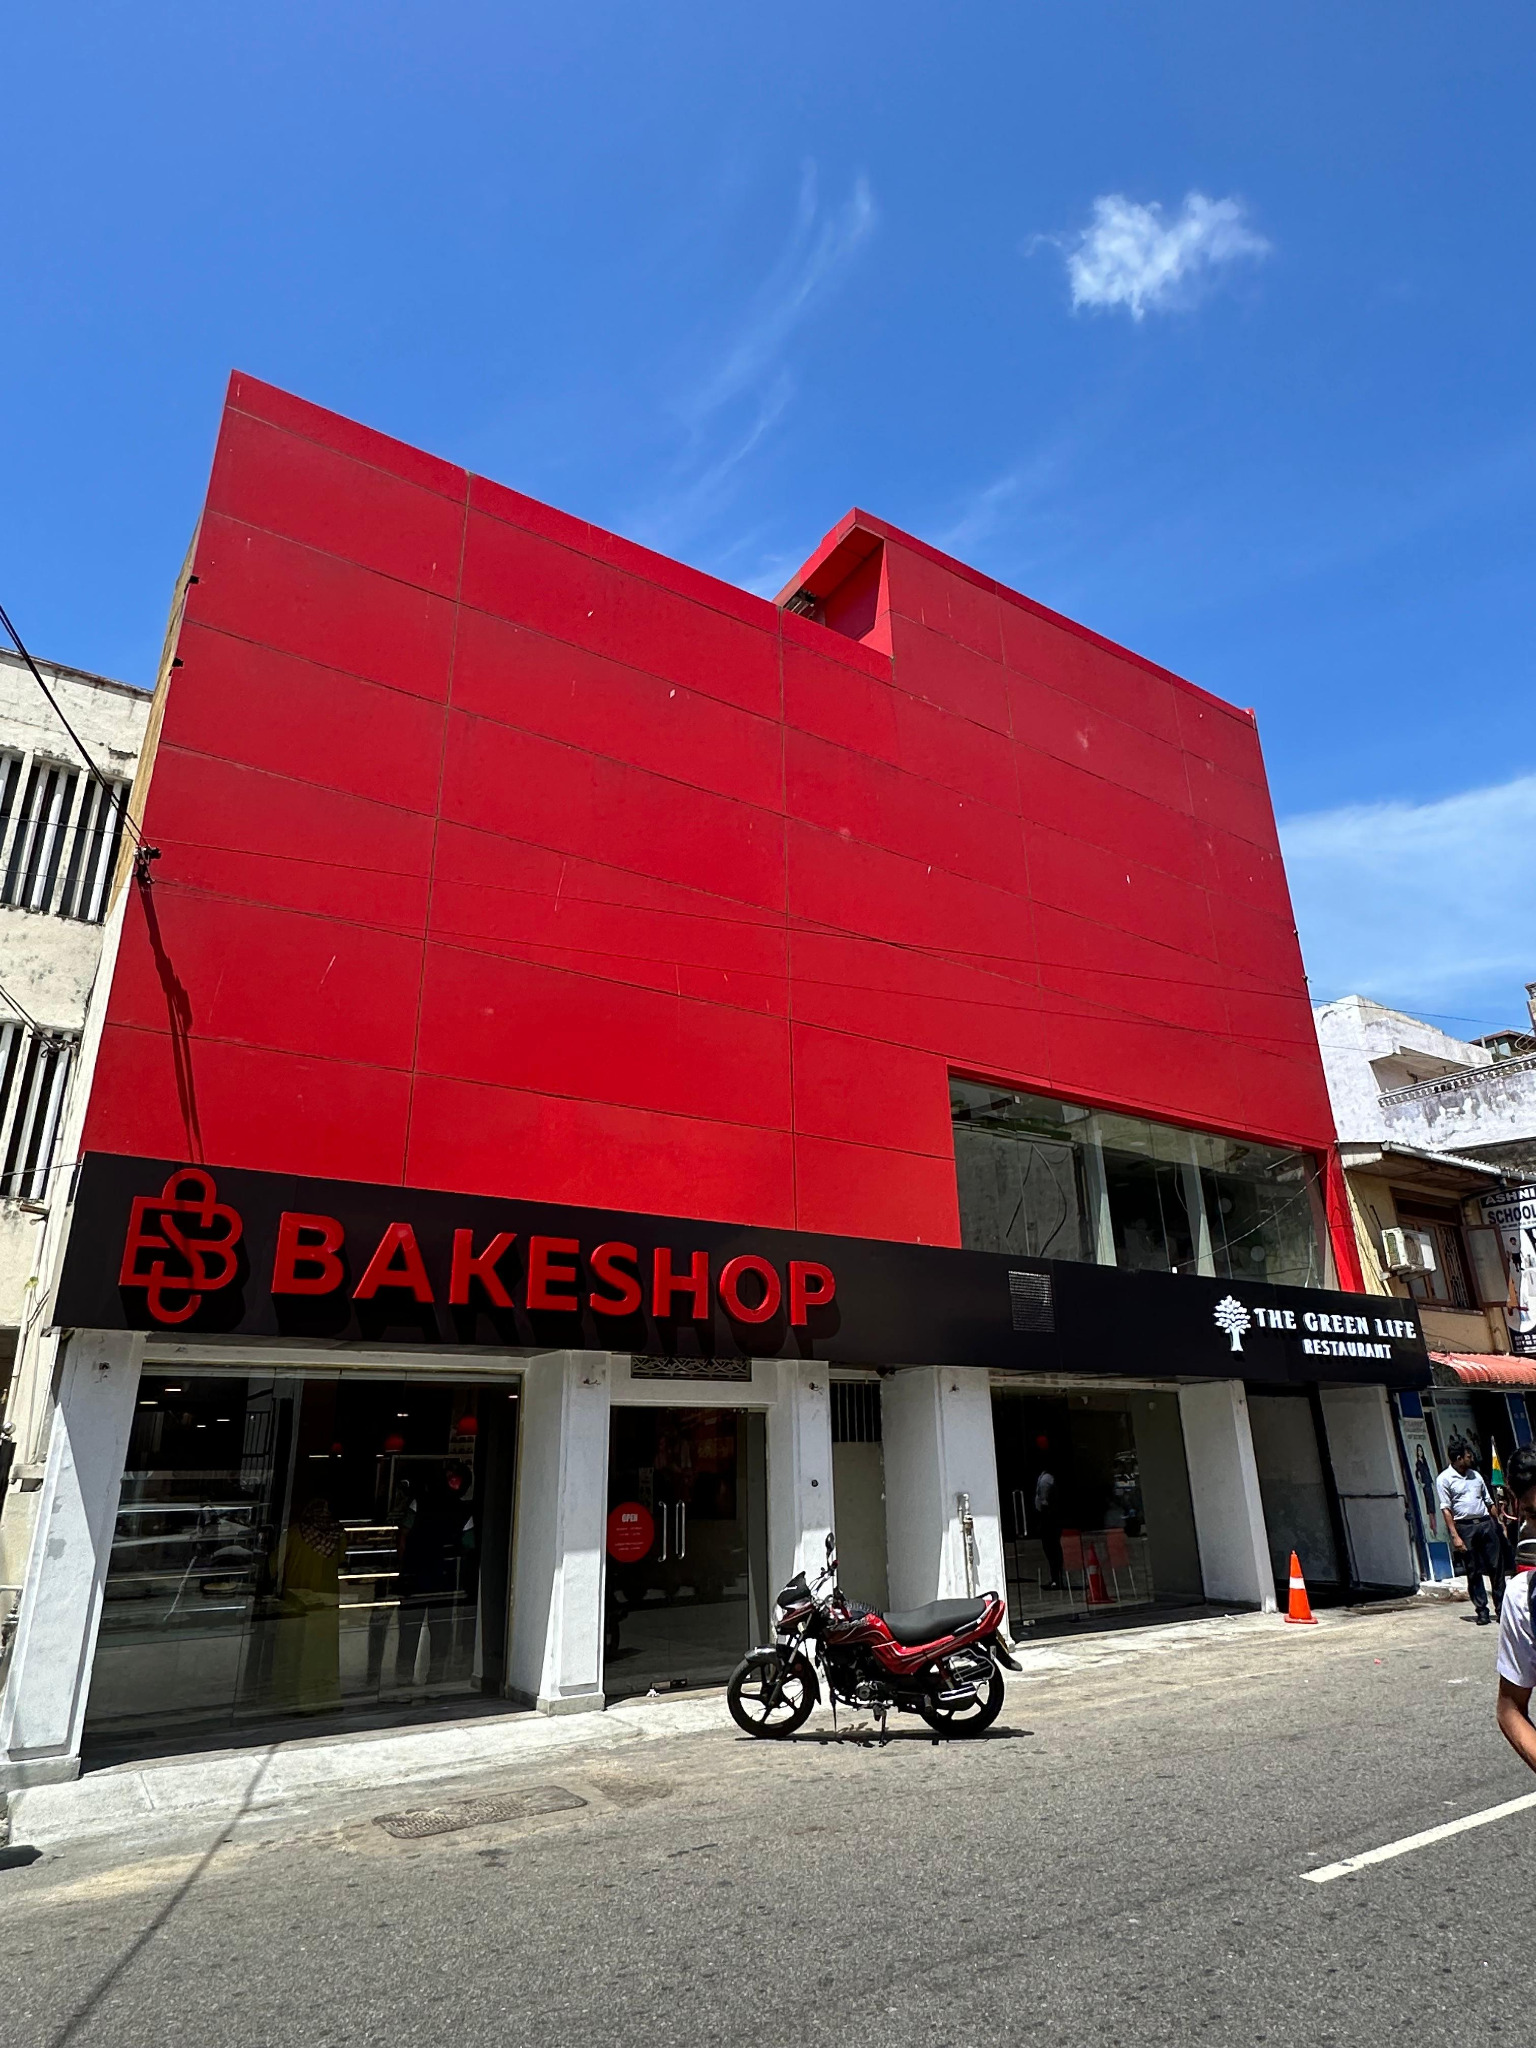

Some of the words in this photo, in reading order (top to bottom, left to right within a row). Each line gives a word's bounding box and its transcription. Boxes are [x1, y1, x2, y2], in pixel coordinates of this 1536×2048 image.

[1487, 1203, 1536, 1224] SCHOOL
[271, 1212, 836, 1326] BAKESHOP
[1253, 1307, 1297, 1330] THE
[1302, 1312, 1370, 1336] GREEN
[1374, 1318, 1417, 1339] LIFE
[1302, 1339, 1392, 1360] RESTAURANT
